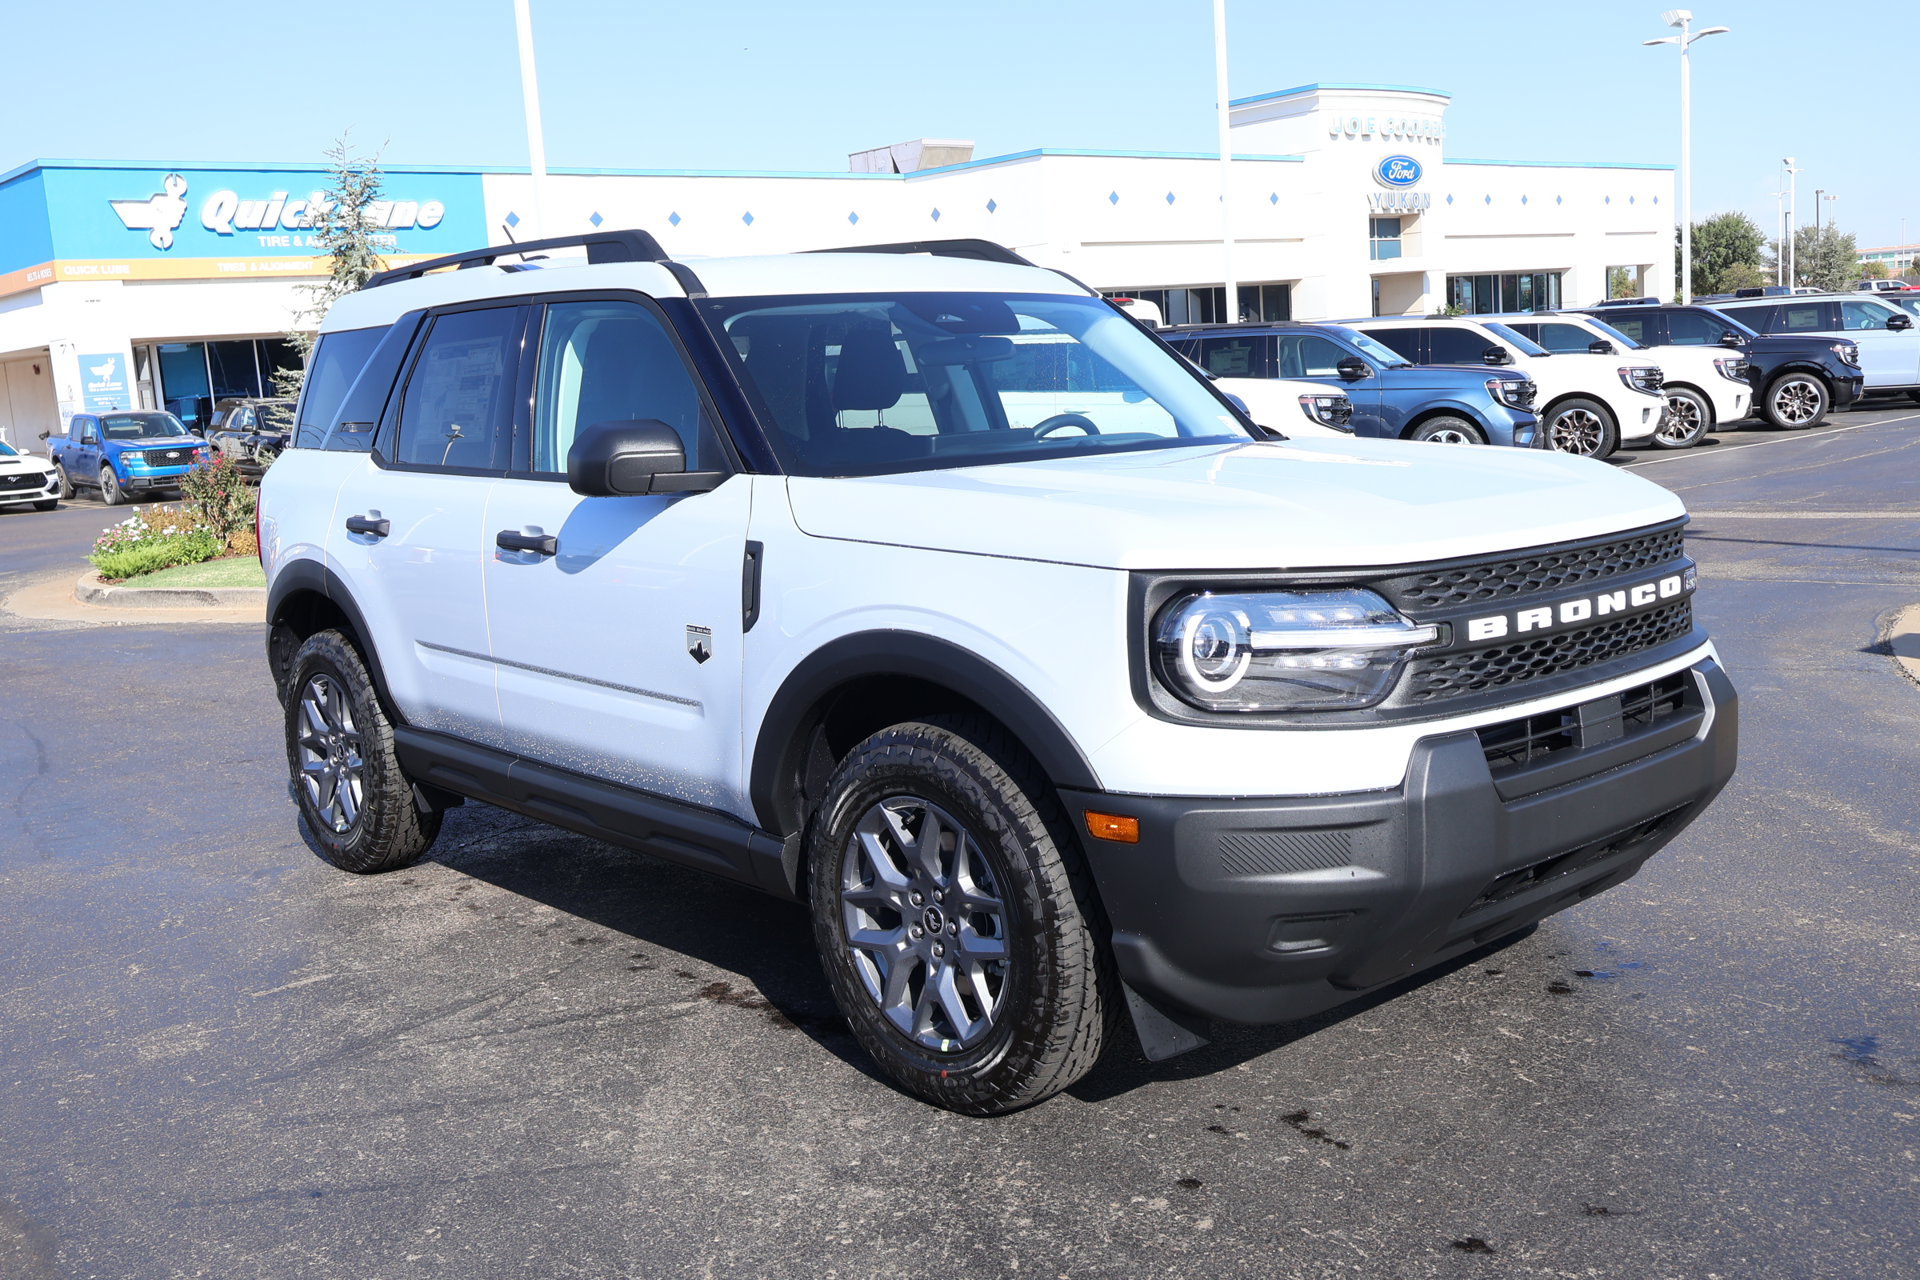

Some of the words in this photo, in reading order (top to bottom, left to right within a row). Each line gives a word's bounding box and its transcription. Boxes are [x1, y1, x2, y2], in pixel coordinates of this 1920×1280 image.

[1330, 117, 1376, 139] JOE
[1388, 160, 1416, 180] Ford
[1371, 192, 1430, 210] YUKON
[257, 235, 290, 247] TIRE
[293, 235, 303, 247] &
[64, 265, 98, 274] QUICK
[101, 264, 129, 274] LUBE
[1468, 575, 1681, 641] BRONCO
